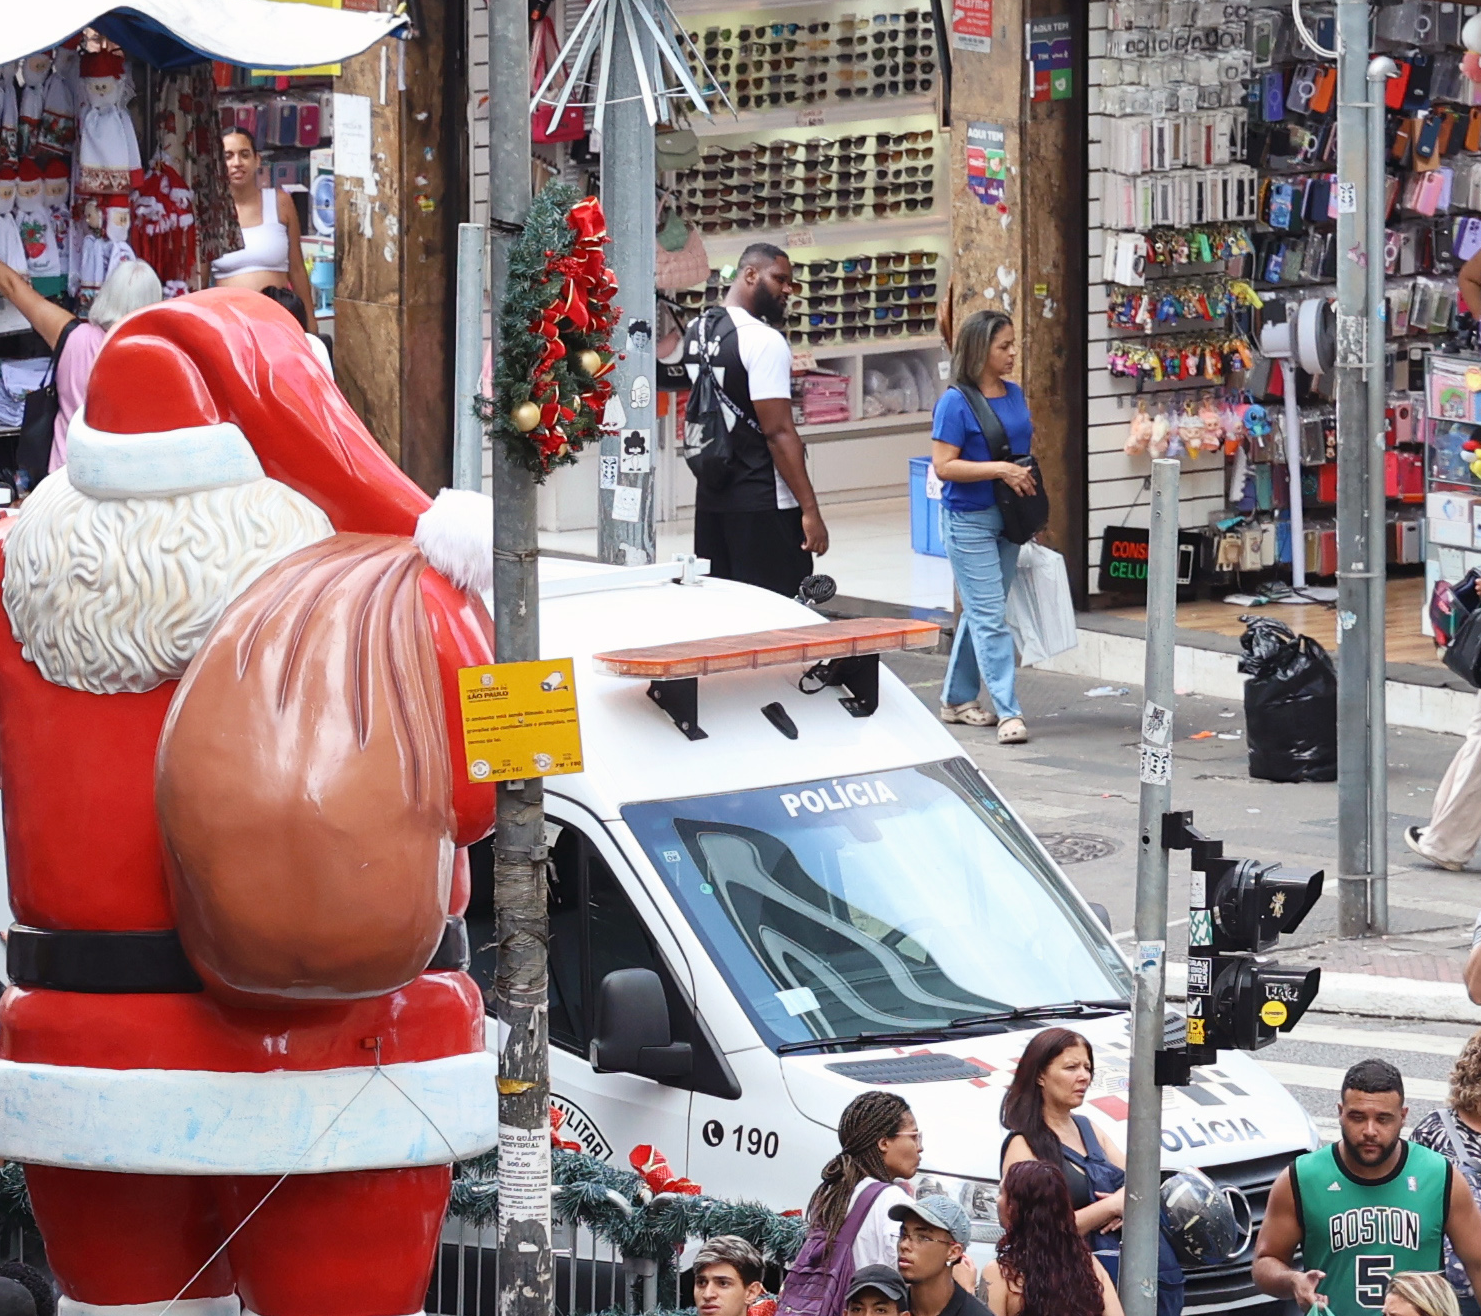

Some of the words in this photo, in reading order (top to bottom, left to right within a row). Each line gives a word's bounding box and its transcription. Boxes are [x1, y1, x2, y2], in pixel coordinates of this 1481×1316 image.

[1032, 23, 1052, 34] AQUI
[1053, 21, 1070, 32] TEM
[967, 126, 986, 139] AQUI
[987, 130, 1004, 142] TEM
[1111, 540, 1149, 560] CONS
[1109, 561, 1149, 580] CELU
[484, 690, 509, 699] PAULO
[779, 780, 899, 818] POLÍCIA
[731, 1124, 780, 1159] 190
[1159, 1115, 1267, 1153] OLÍCIA
[1329, 1206, 1421, 1254] BOSTON
[1355, 1254, 1395, 1310] 5
